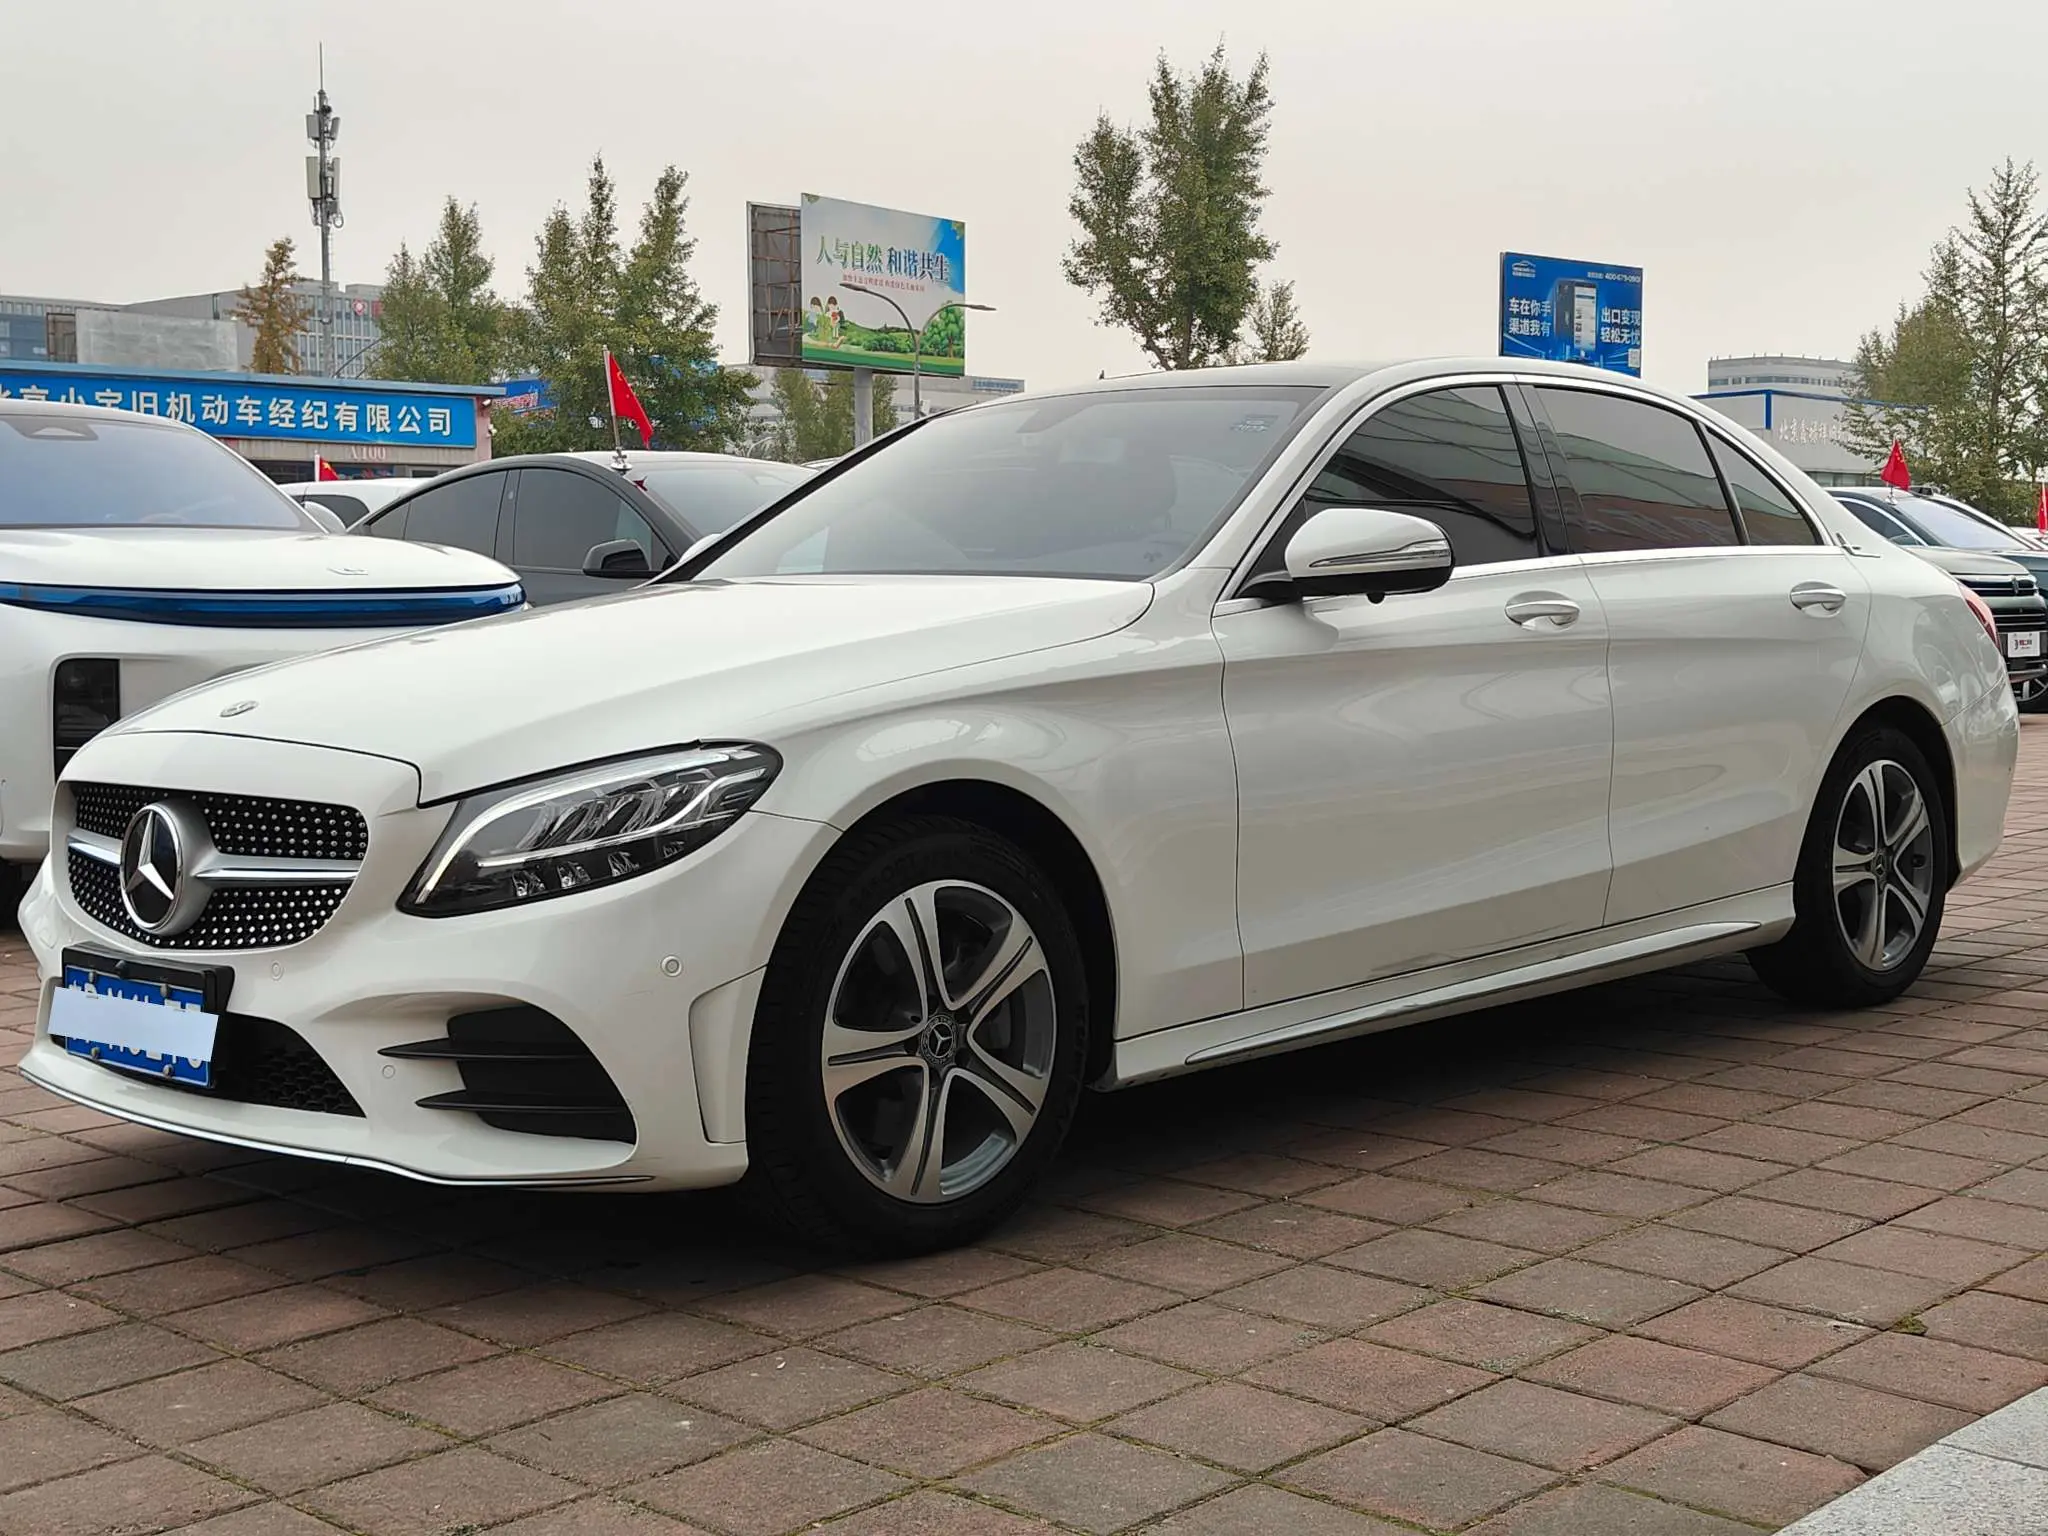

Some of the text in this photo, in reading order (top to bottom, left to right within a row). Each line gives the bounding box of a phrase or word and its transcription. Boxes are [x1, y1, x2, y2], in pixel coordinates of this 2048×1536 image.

[816, 235, 883, 274] 人与自然
[887, 246, 949, 283] 和谐共生
[1509, 297, 1552, 316] 车在你手
[1601, 306, 1641, 326] 出口变现
[1509, 317, 1551, 337] 渠道我有
[1600, 326, 1641, 345] 轻松无忧
